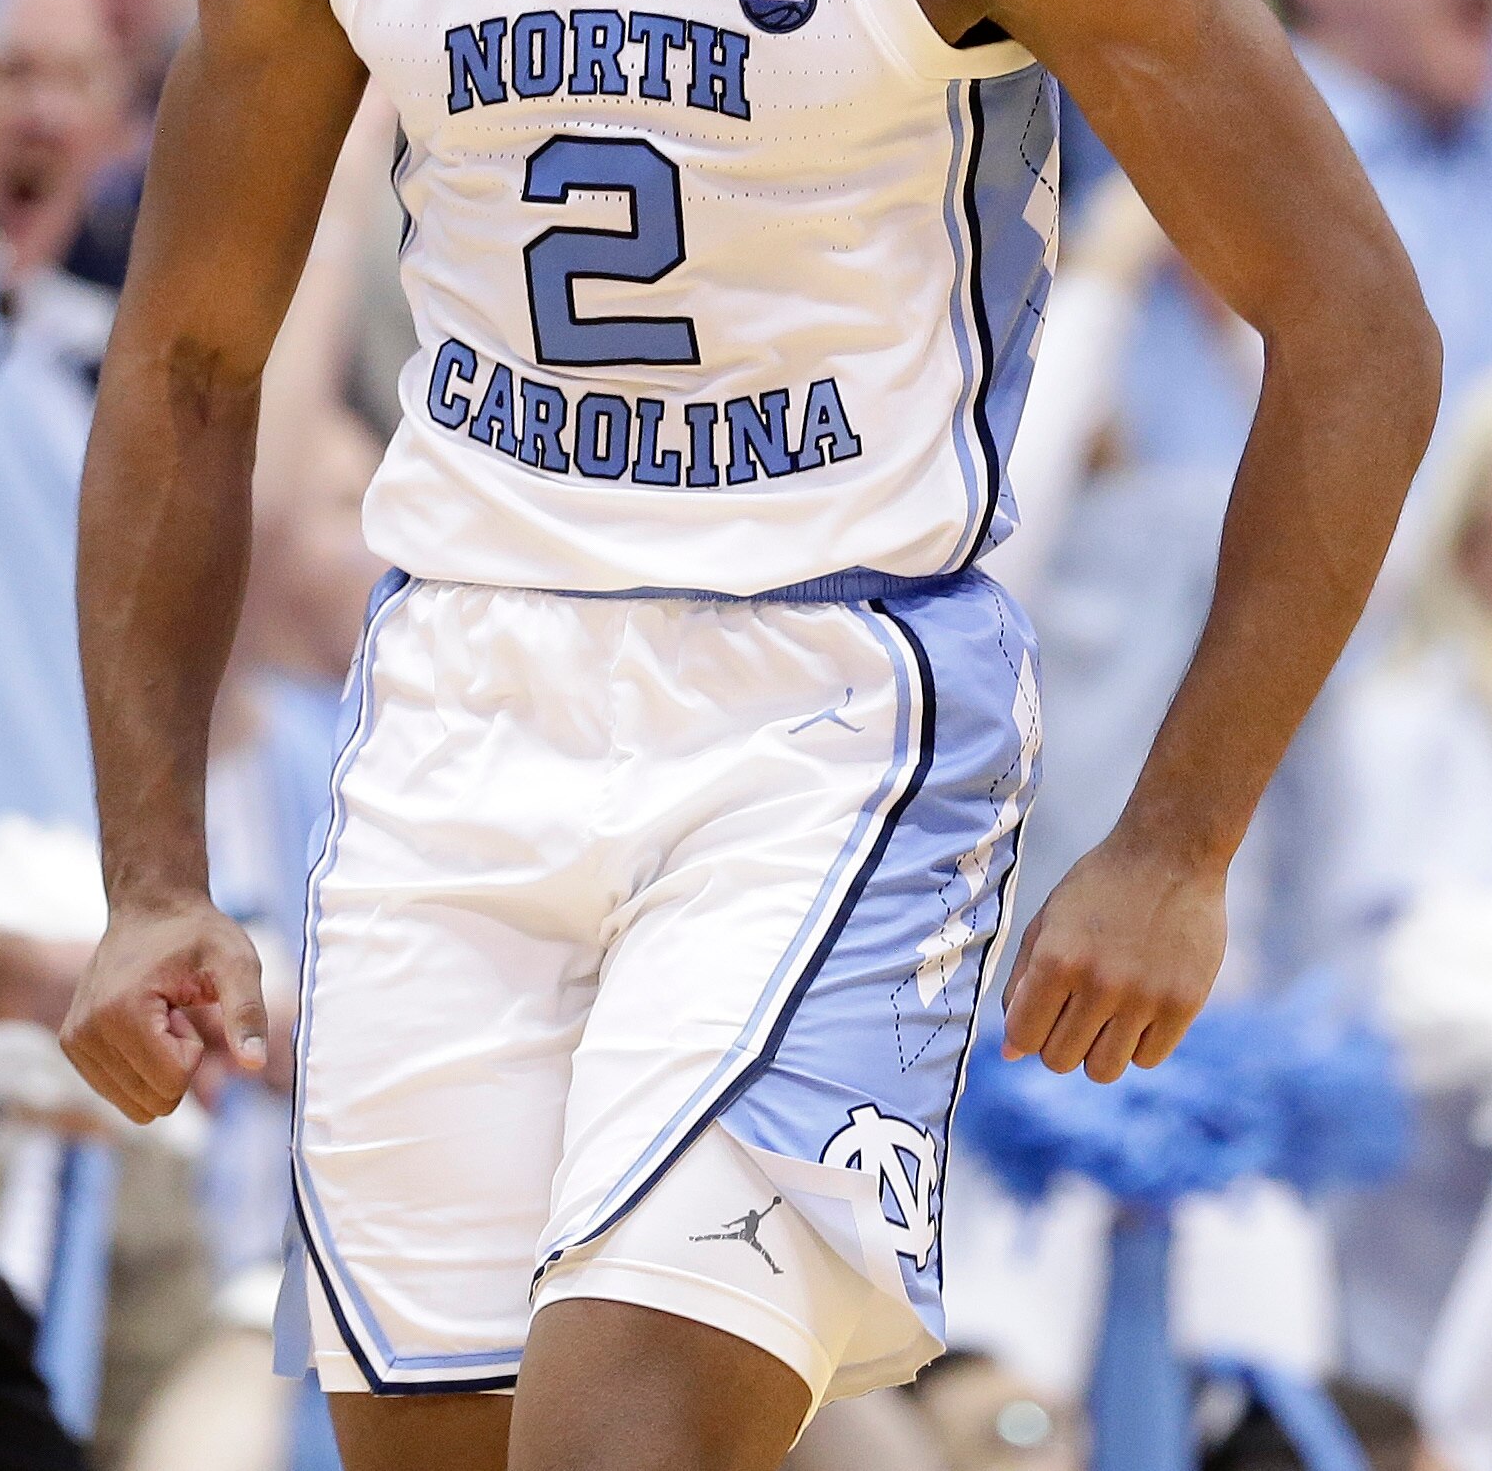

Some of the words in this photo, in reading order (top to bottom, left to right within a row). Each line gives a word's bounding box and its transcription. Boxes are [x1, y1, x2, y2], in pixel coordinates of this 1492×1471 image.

[445, 9, 751, 121] NORTH
[521, 134, 701, 366] 2
[427, 337, 862, 488] CAROLINA
